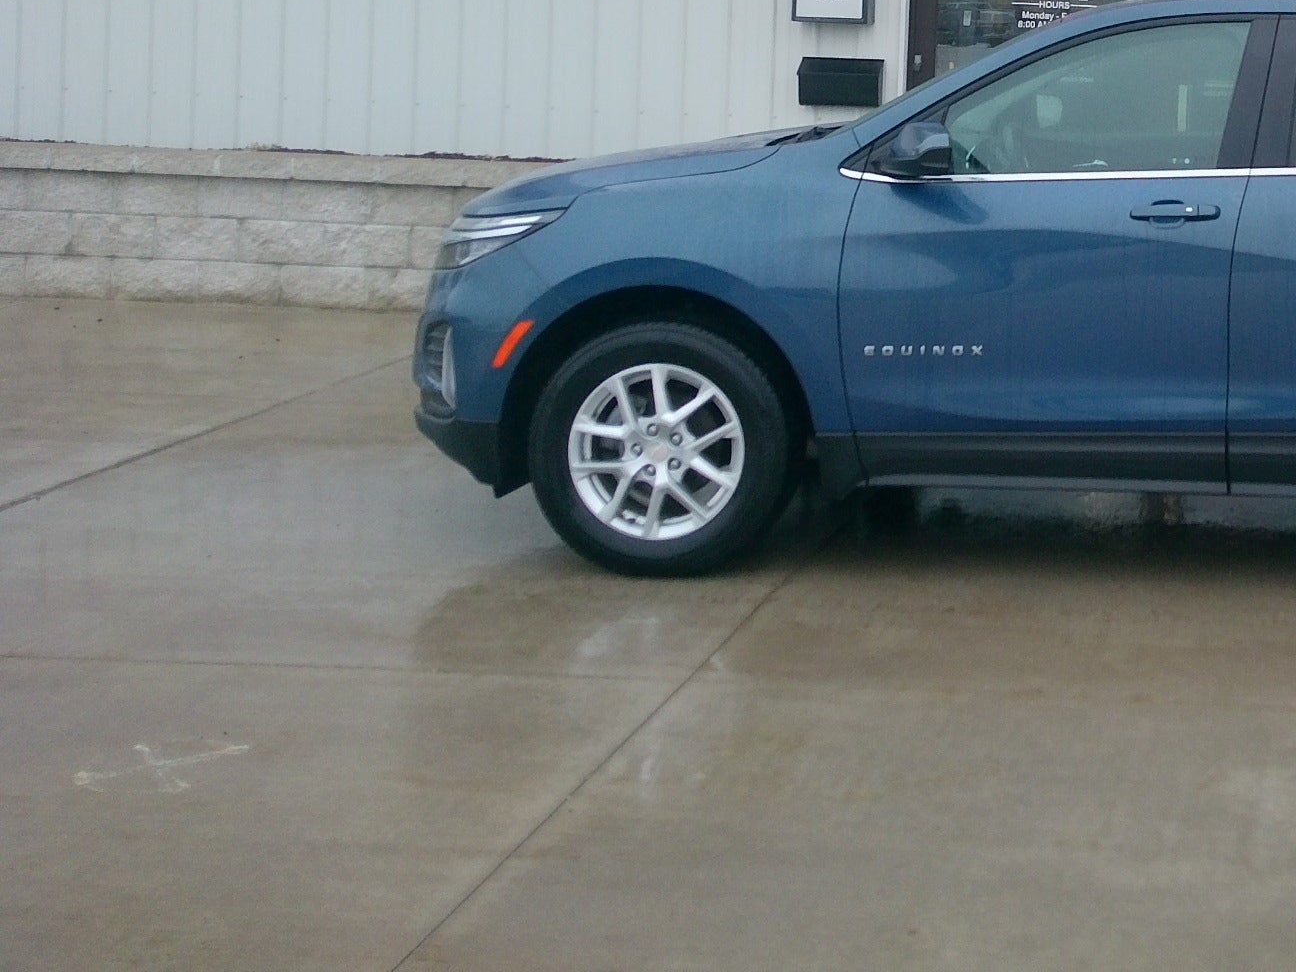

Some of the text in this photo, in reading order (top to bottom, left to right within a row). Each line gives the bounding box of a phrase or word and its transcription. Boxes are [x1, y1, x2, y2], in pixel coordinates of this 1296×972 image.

[1038, 0, 1071, 9] HOURS
[1021, 11, 1055, 22] Monday
[863, 344, 984, 357] EQUINOX
